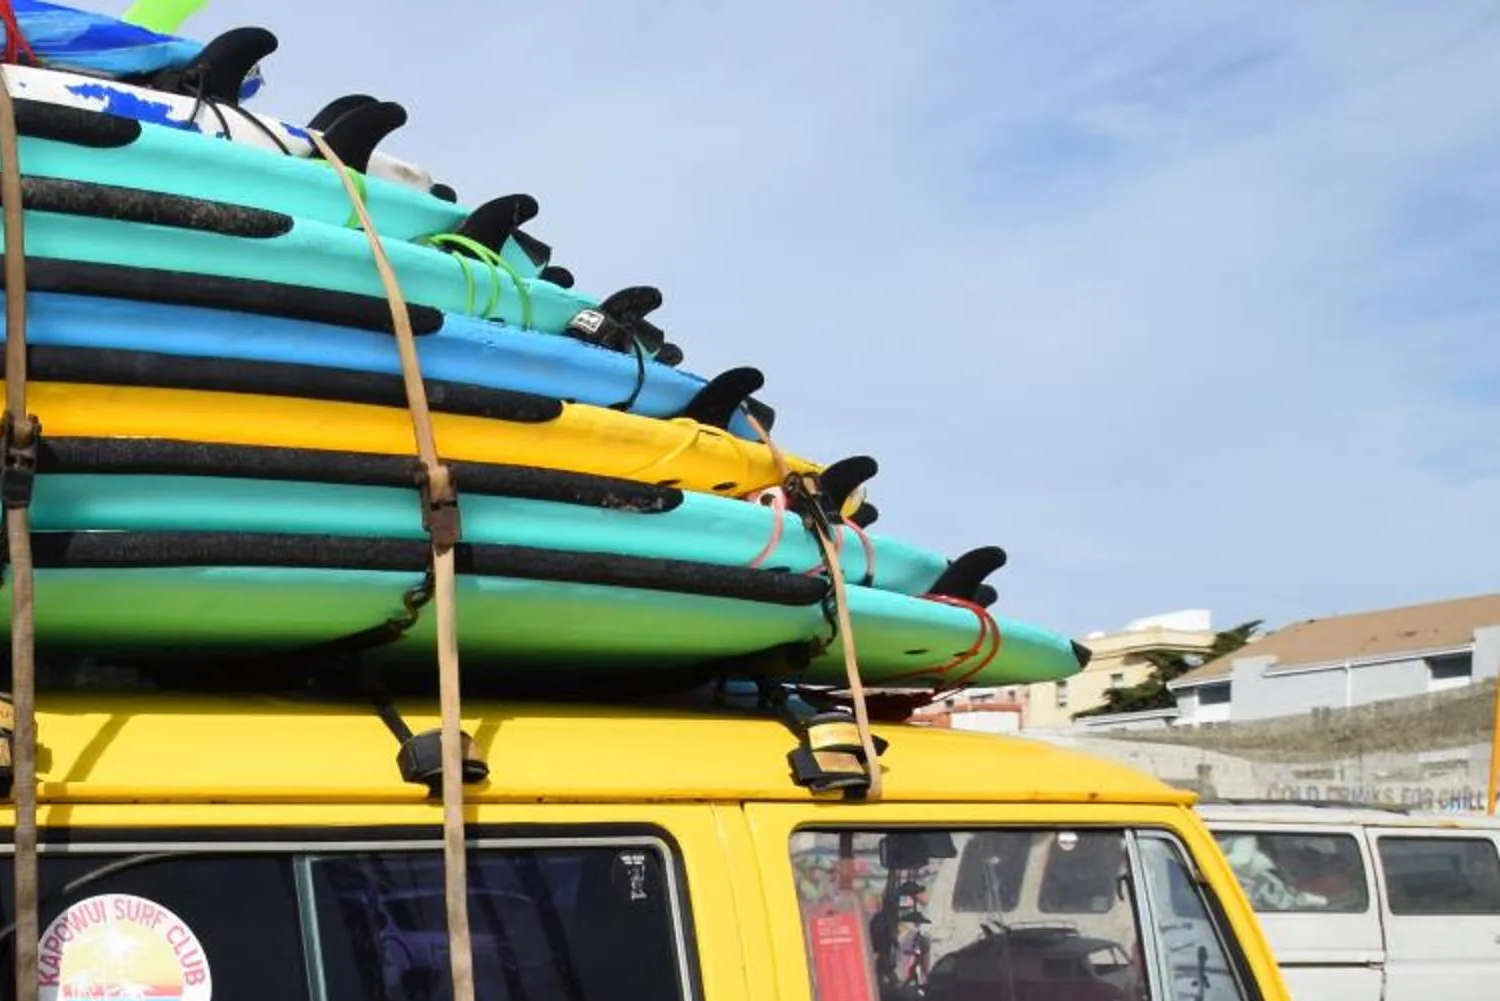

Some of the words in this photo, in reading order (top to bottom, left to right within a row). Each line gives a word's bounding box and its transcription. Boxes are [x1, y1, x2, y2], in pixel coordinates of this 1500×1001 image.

[38, 901, 107, 987] KAPOWUI
[113, 898, 168, 929] SURF
[166, 925, 207, 986] CLUB
